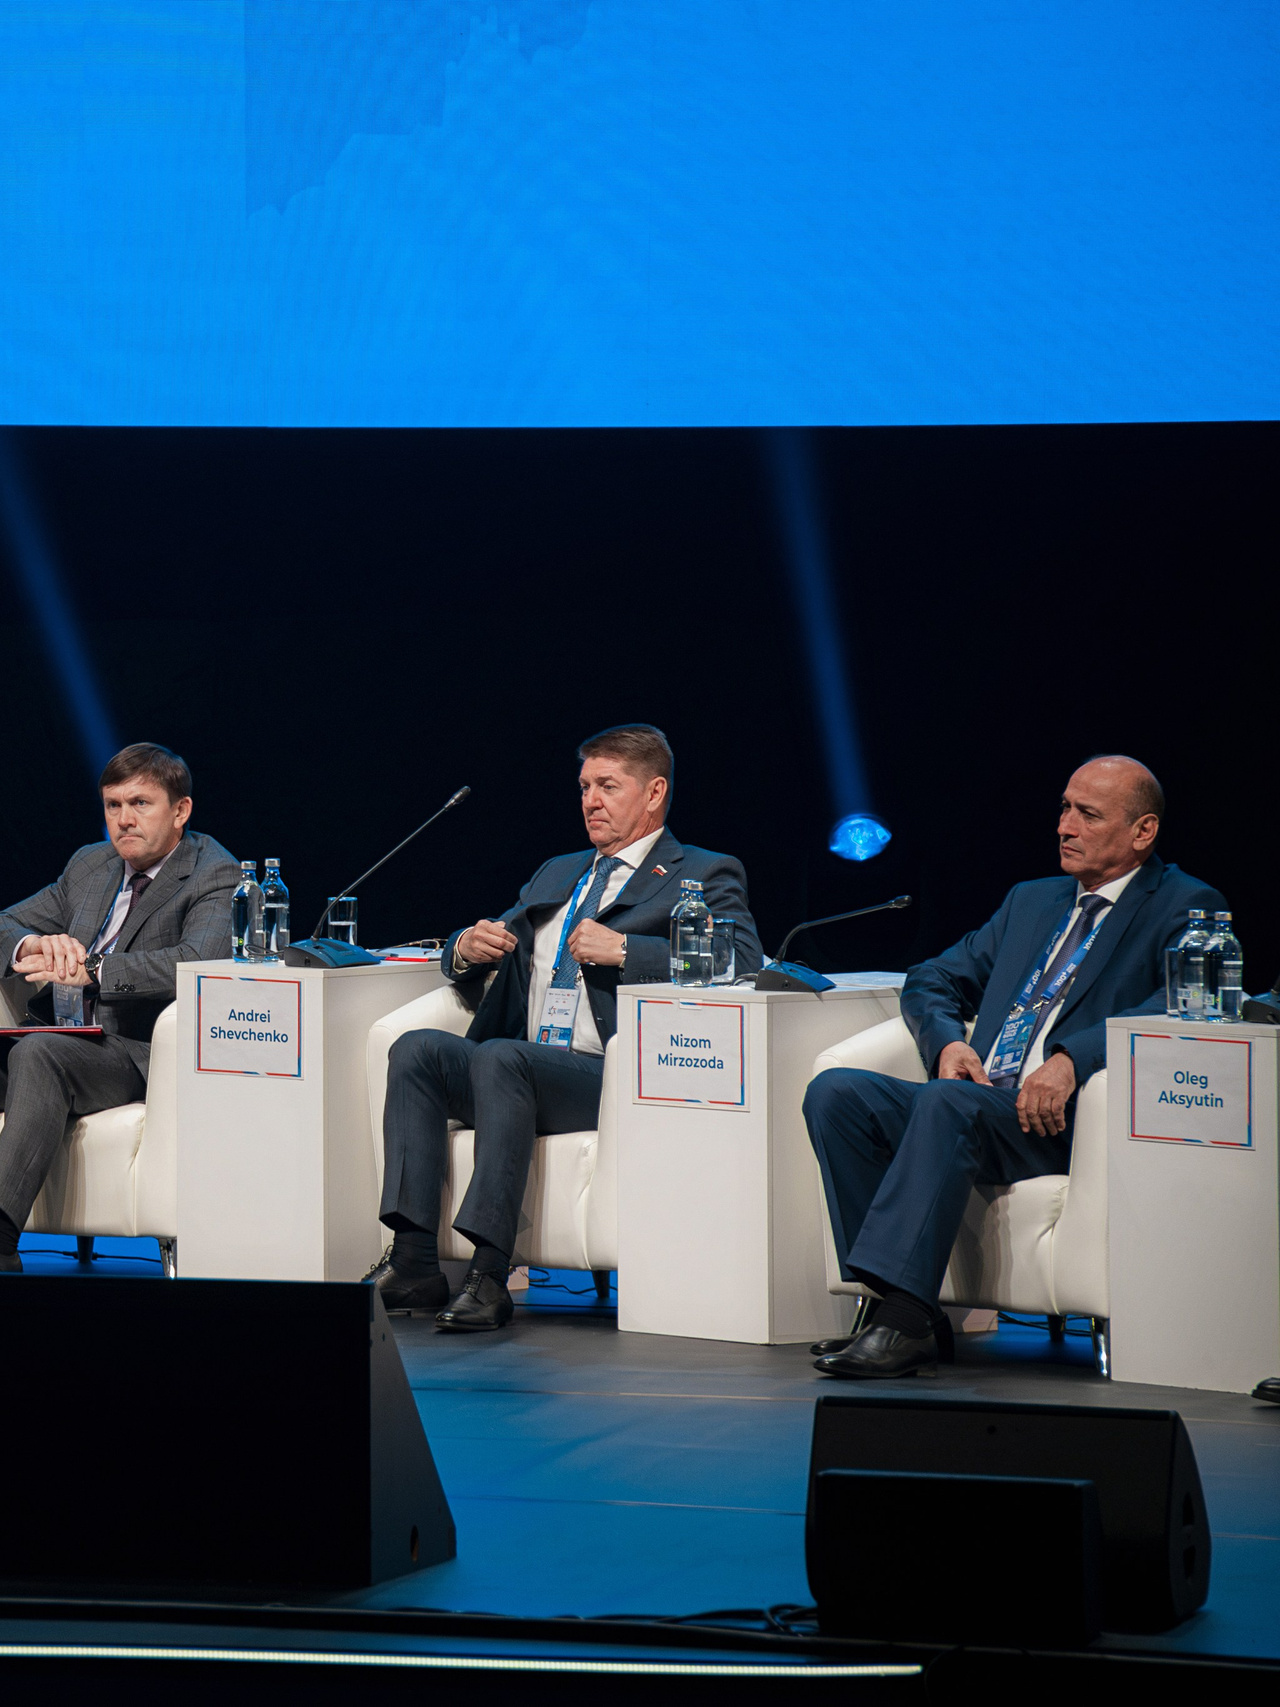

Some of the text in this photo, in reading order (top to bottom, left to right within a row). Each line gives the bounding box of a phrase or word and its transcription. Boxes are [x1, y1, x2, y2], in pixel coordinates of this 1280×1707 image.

[227, 1008, 271, 1023] Andrei
[210, 1026, 289, 1044] Shevchenko
[669, 1033, 712, 1050] Nizom
[656, 1052, 724, 1070] Mirzozoda
[1173, 1070, 1208, 1088] Oleg
[1157, 1090, 1224, 1109] Aksyutin
